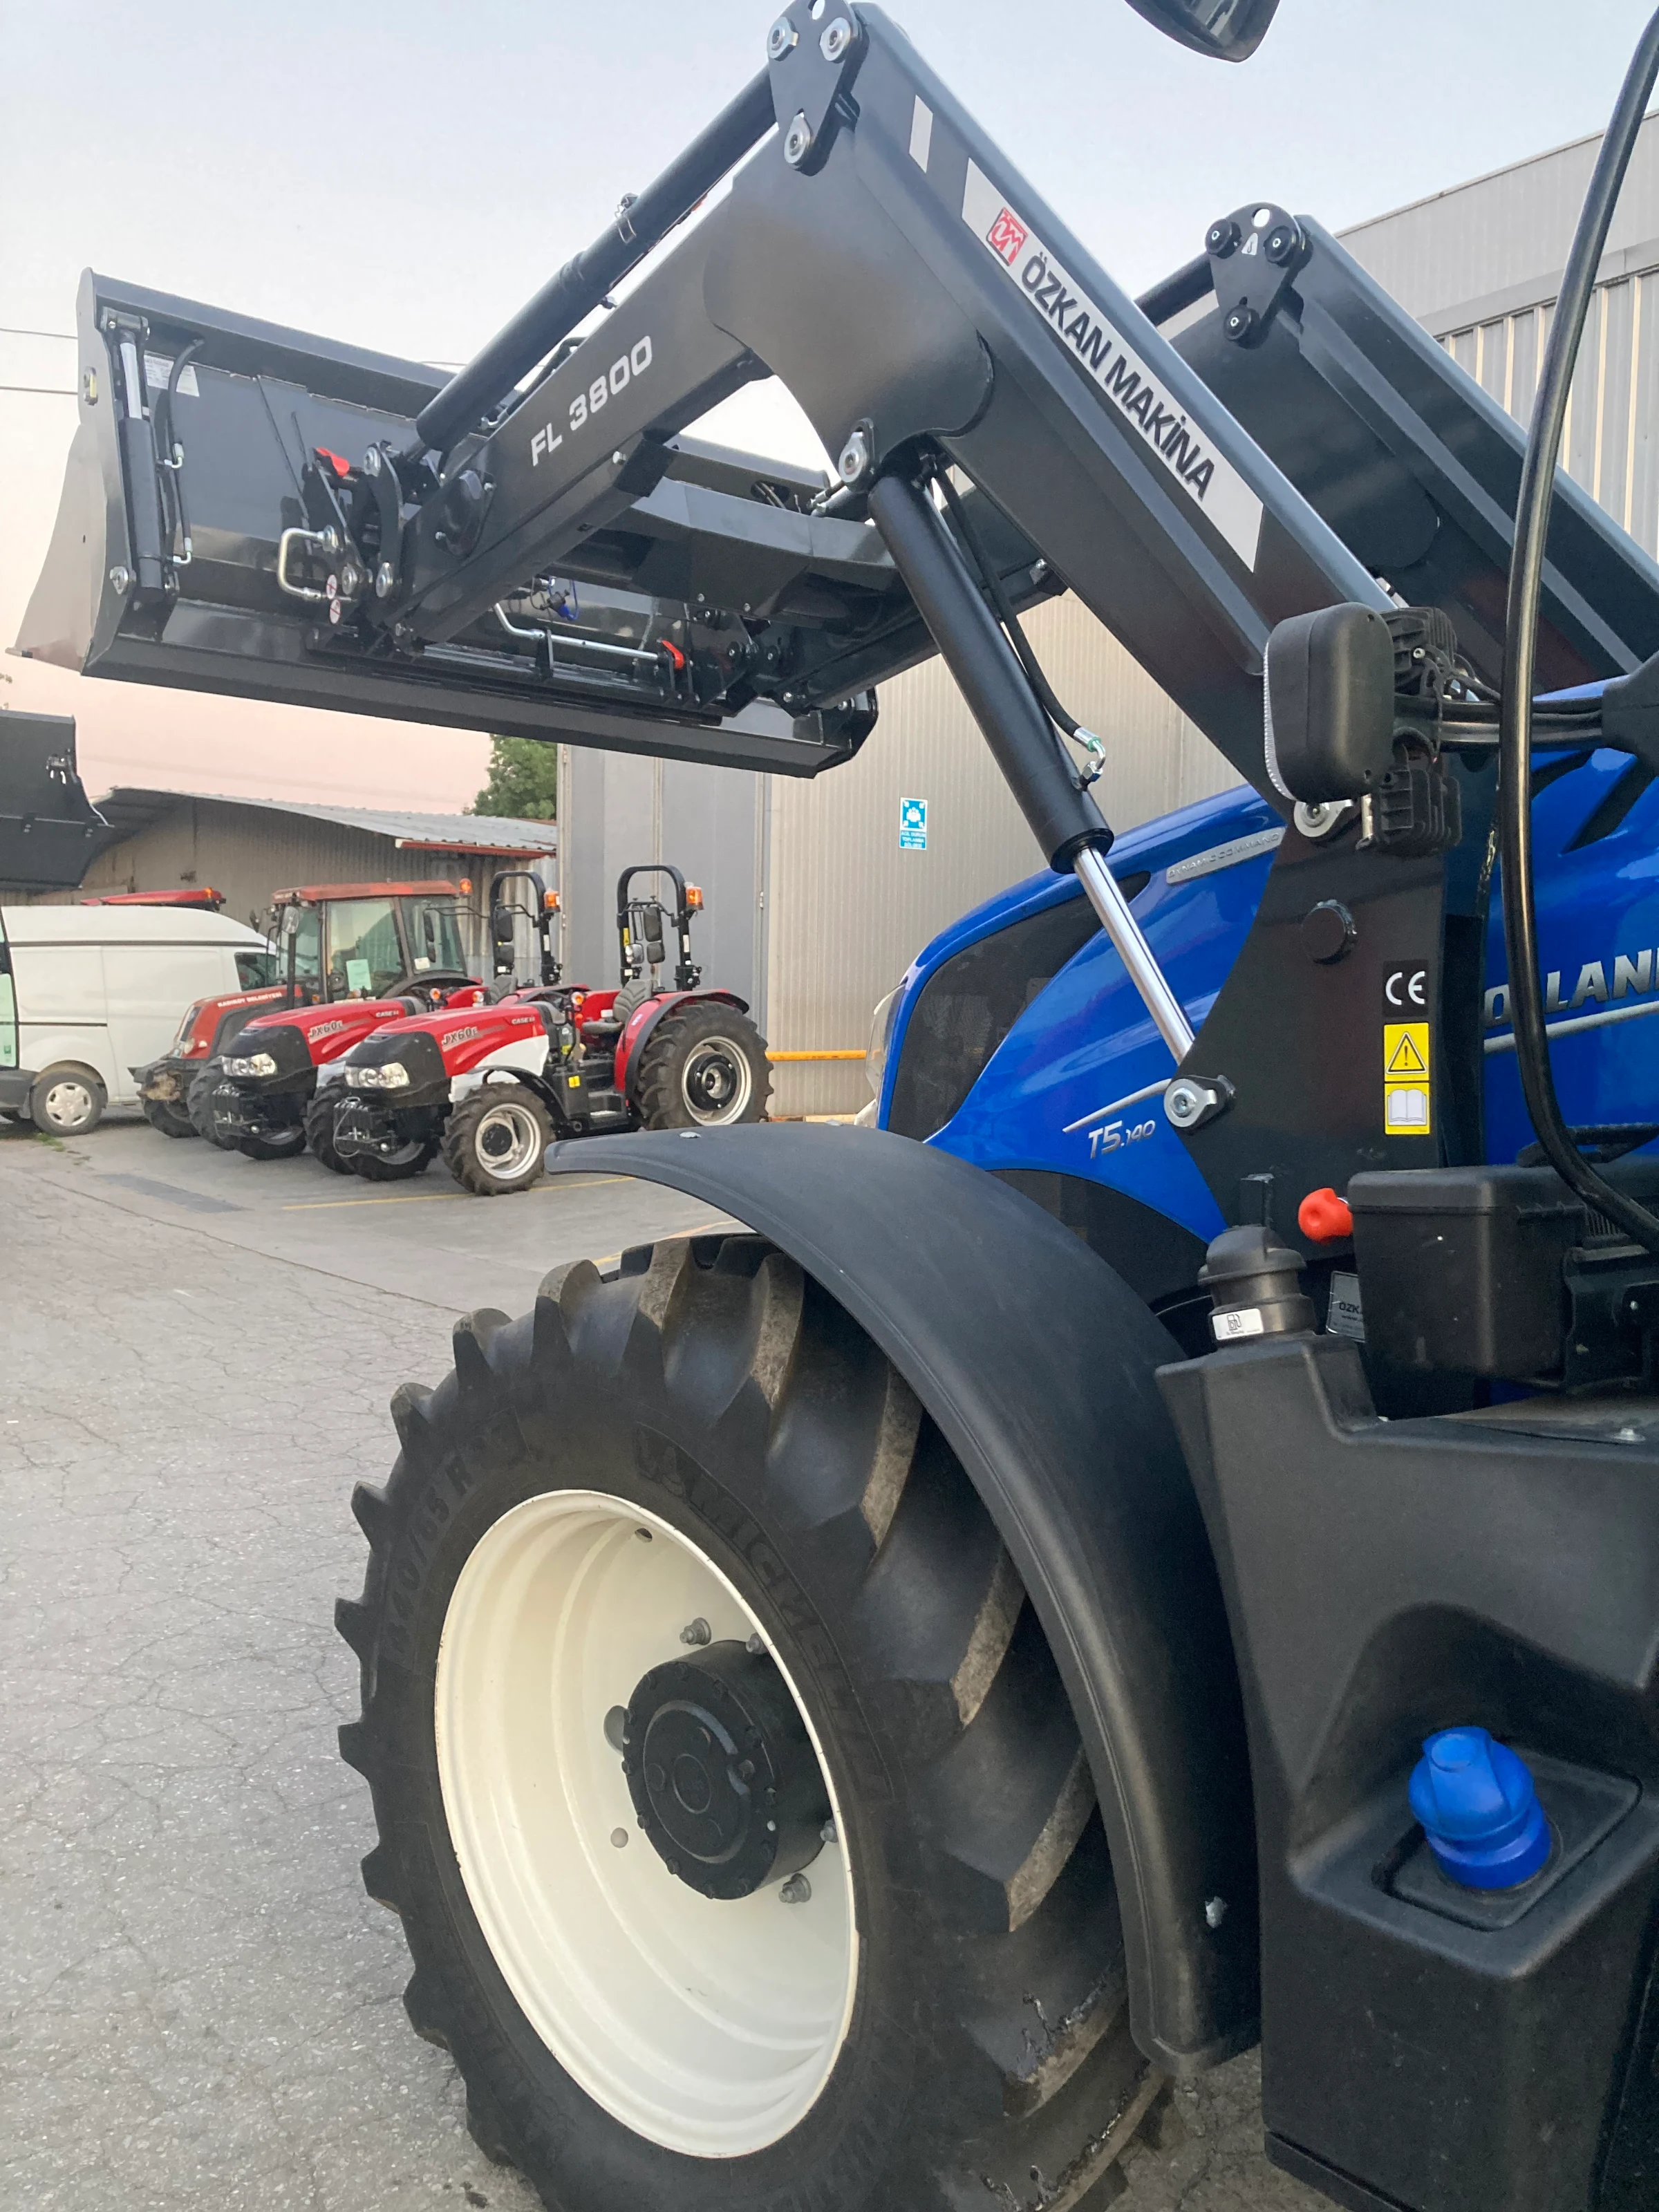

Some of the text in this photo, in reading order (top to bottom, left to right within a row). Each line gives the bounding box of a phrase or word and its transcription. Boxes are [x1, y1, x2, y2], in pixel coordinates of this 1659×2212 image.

[531, 335, 653, 467] FL 3800
[1022, 252, 1215, 501] ÖZKAN MAKİNA
[1168, 832, 1280, 878] DYNAMIC COMMAND
[1385, 971, 1425, 1005] CE
[1484, 947, 1659, 1029] OLAN
[1088, 1119, 1156, 1159] T5.140
